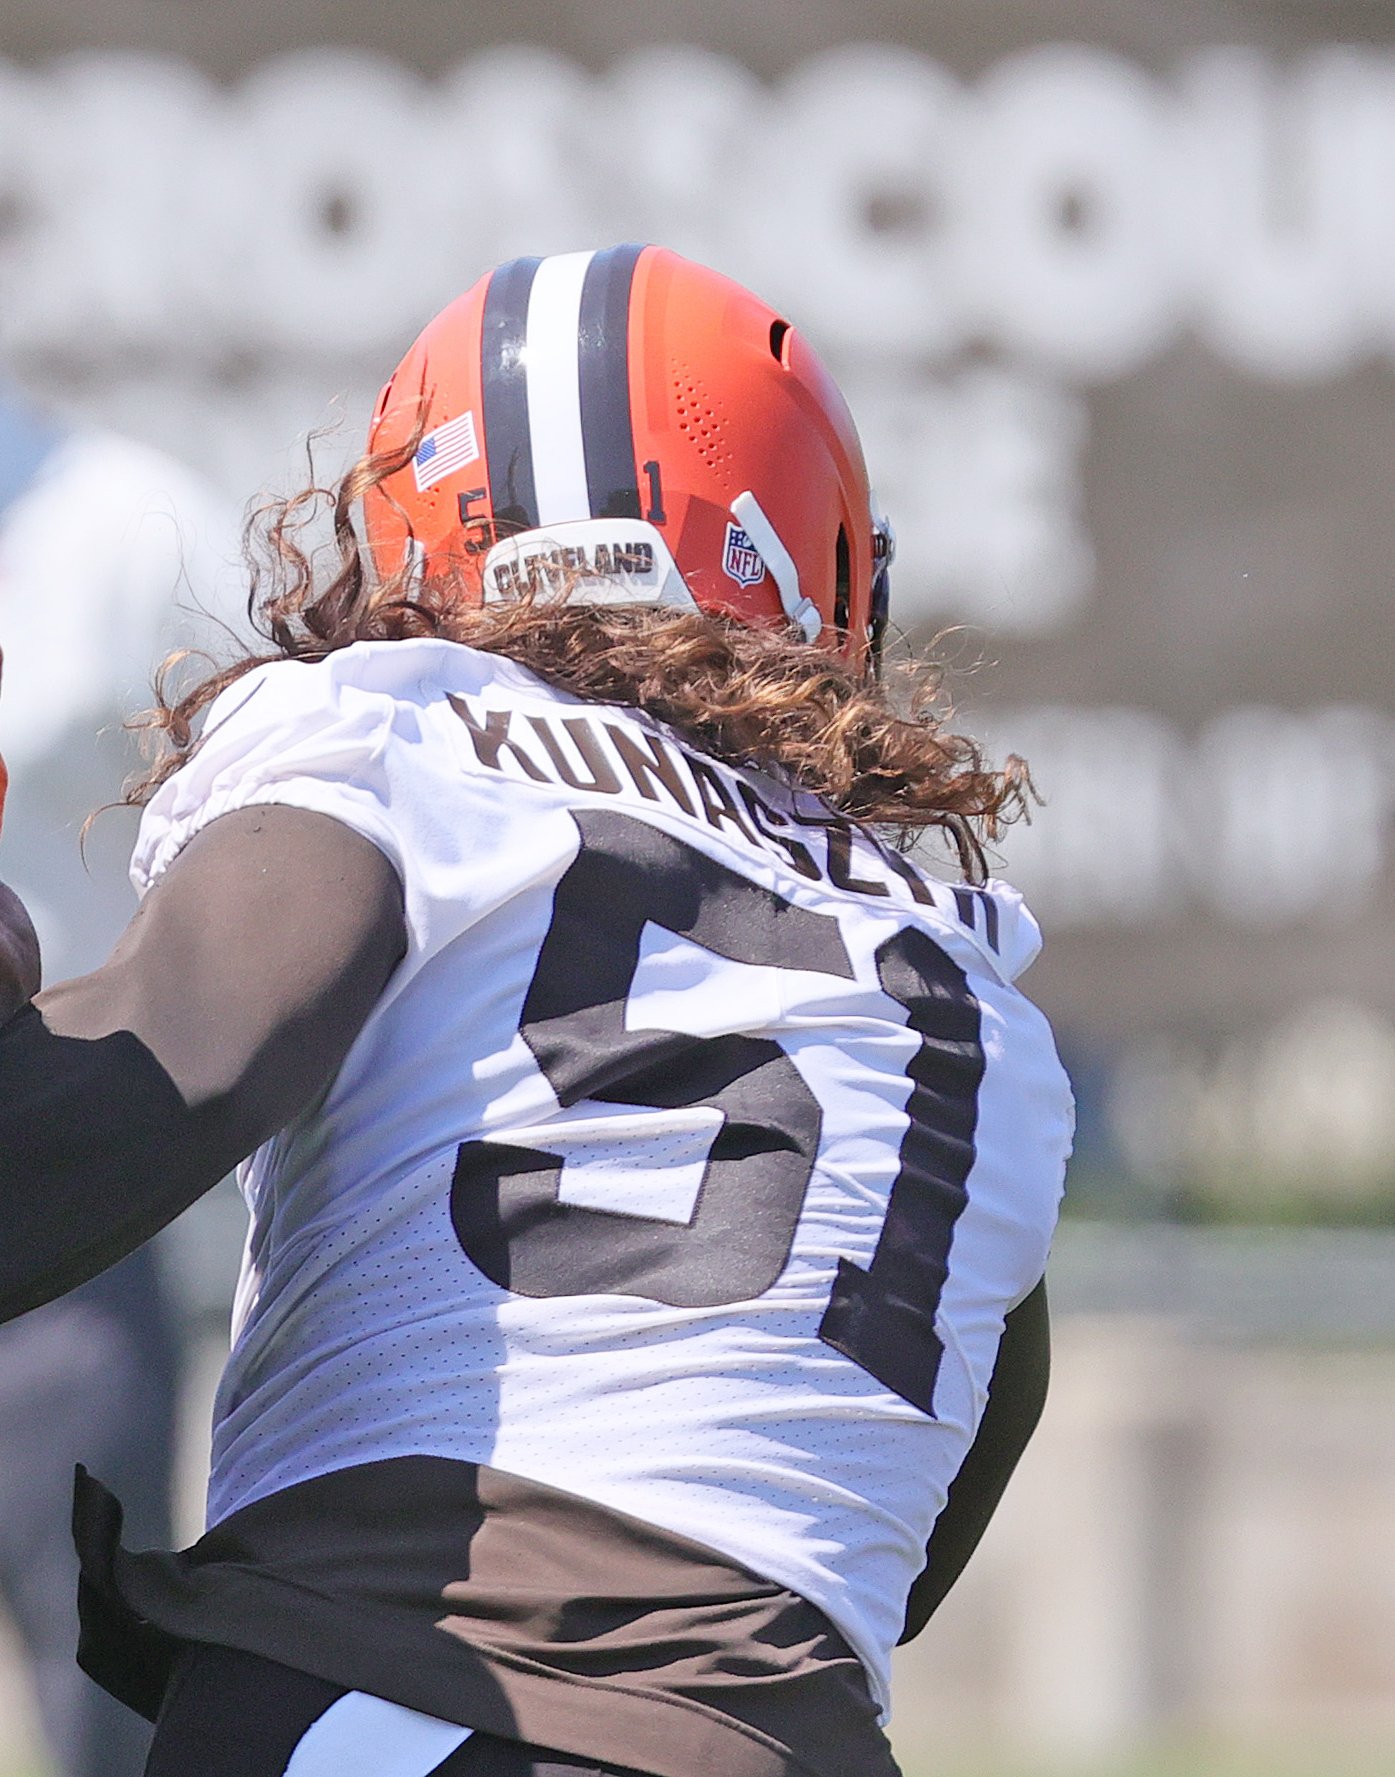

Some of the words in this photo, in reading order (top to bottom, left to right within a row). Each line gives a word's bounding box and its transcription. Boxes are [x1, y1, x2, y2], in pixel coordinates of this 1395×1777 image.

[641, 460, 667, 523] 1
[492, 542, 654, 597] CLEVELAND
[730, 552, 761, 579] NFL
[450, 808, 967, 1421] 51
